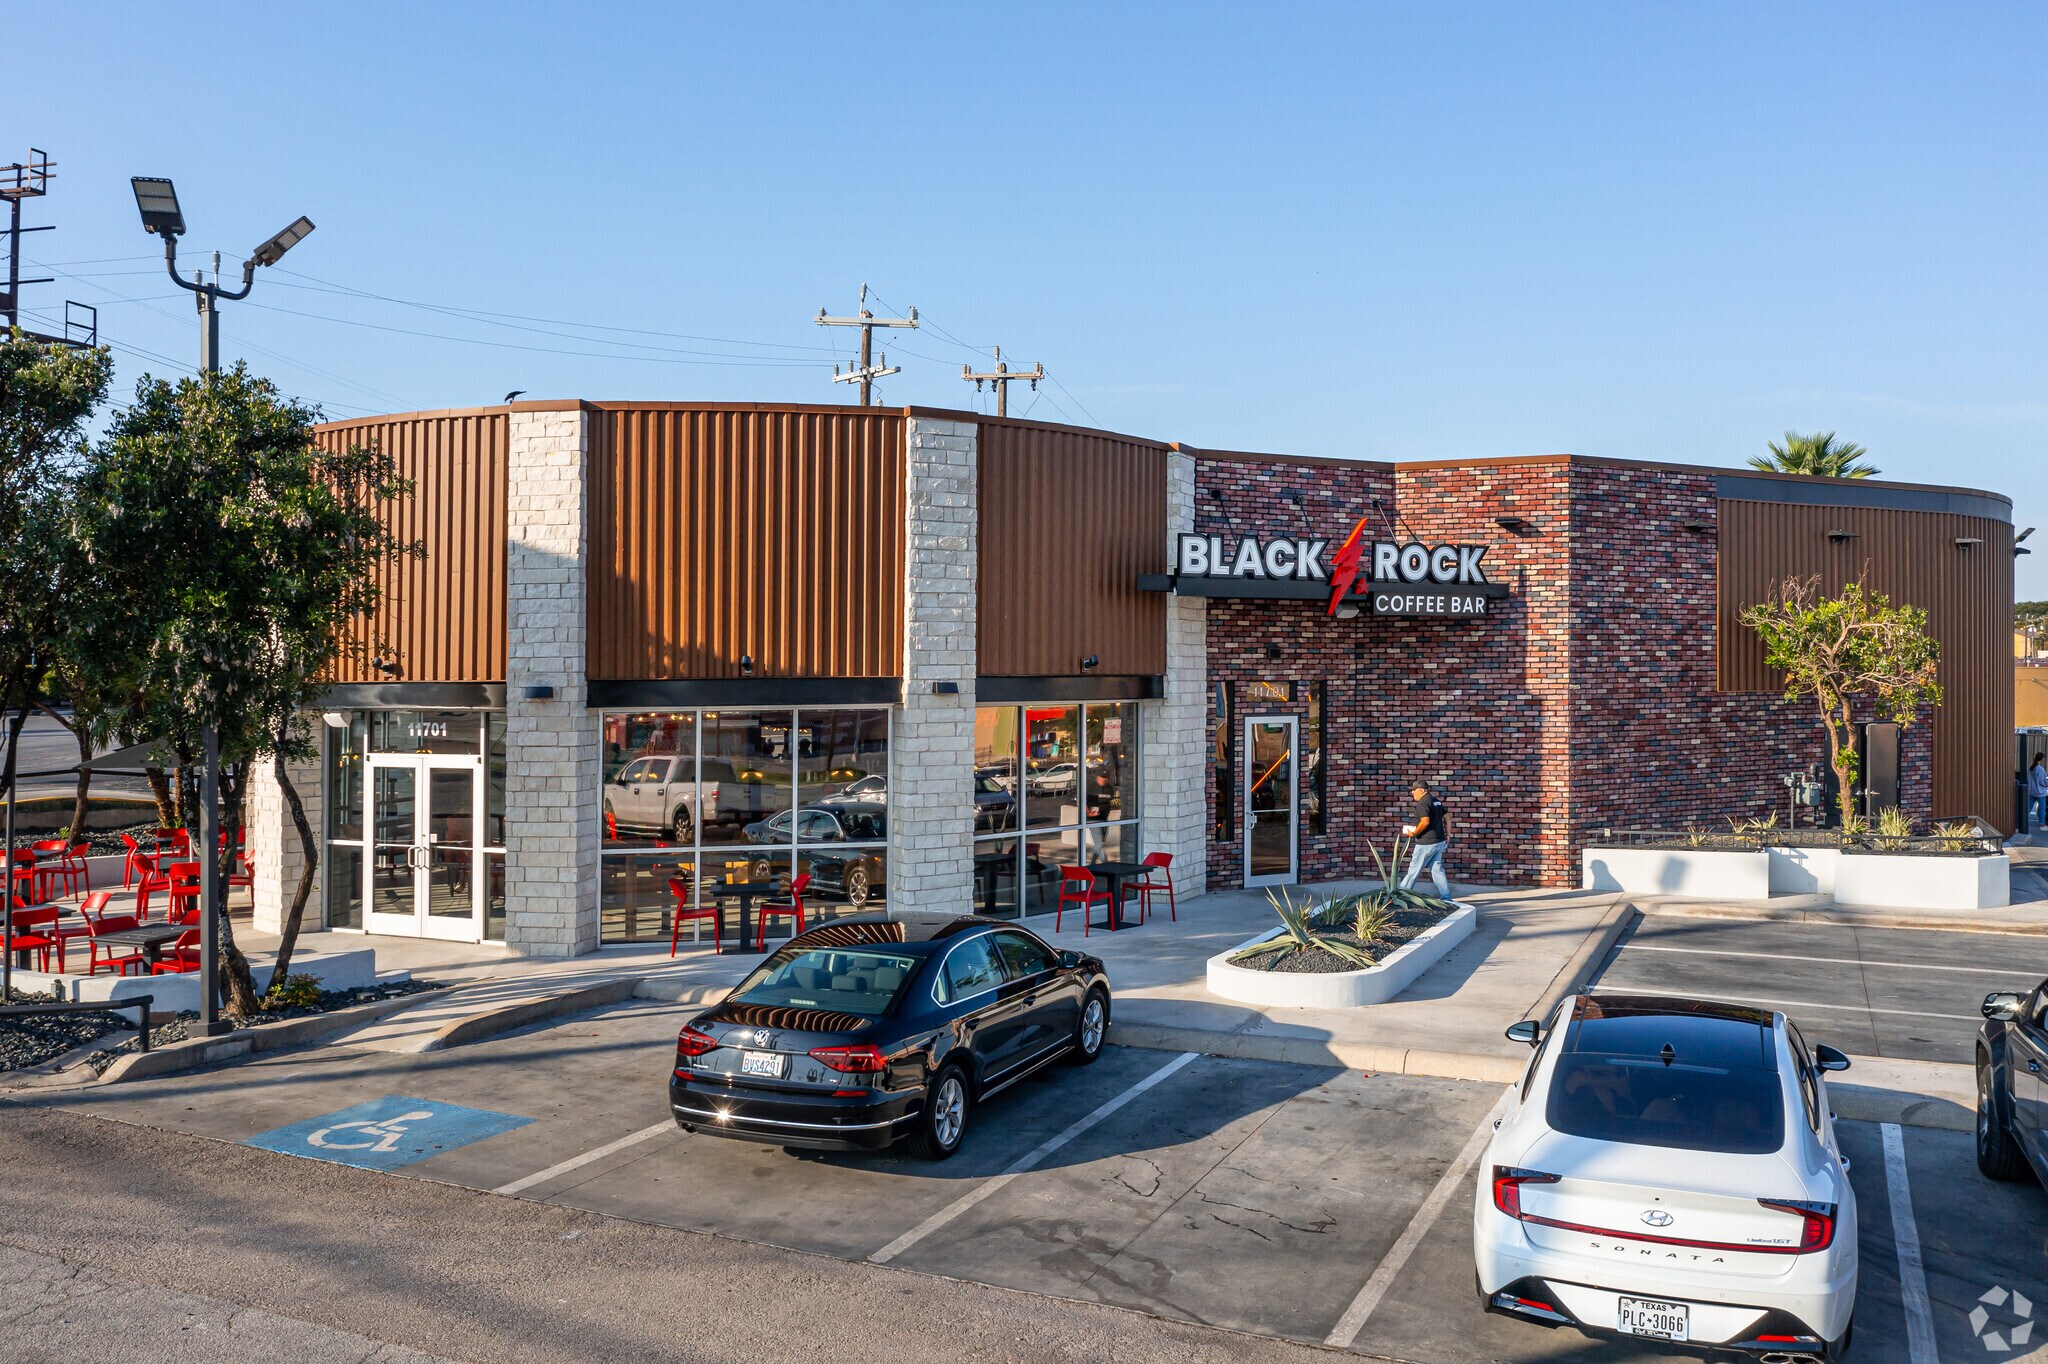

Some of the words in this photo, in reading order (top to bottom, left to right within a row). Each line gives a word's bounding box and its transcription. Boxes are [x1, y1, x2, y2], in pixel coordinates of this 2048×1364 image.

[1180, 535, 1327, 579] BLACK
[1374, 541, 1488, 583] ROCK
[1375, 594, 1445, 613] COFFEE
[1450, 596, 1486, 614] BAR
[1254, 686, 1285, 697] 11701
[407, 722, 447, 737] 11701
[1589, 1242, 1725, 1263] SONATA
[1640, 1301, 1667, 1312] TEXAS
